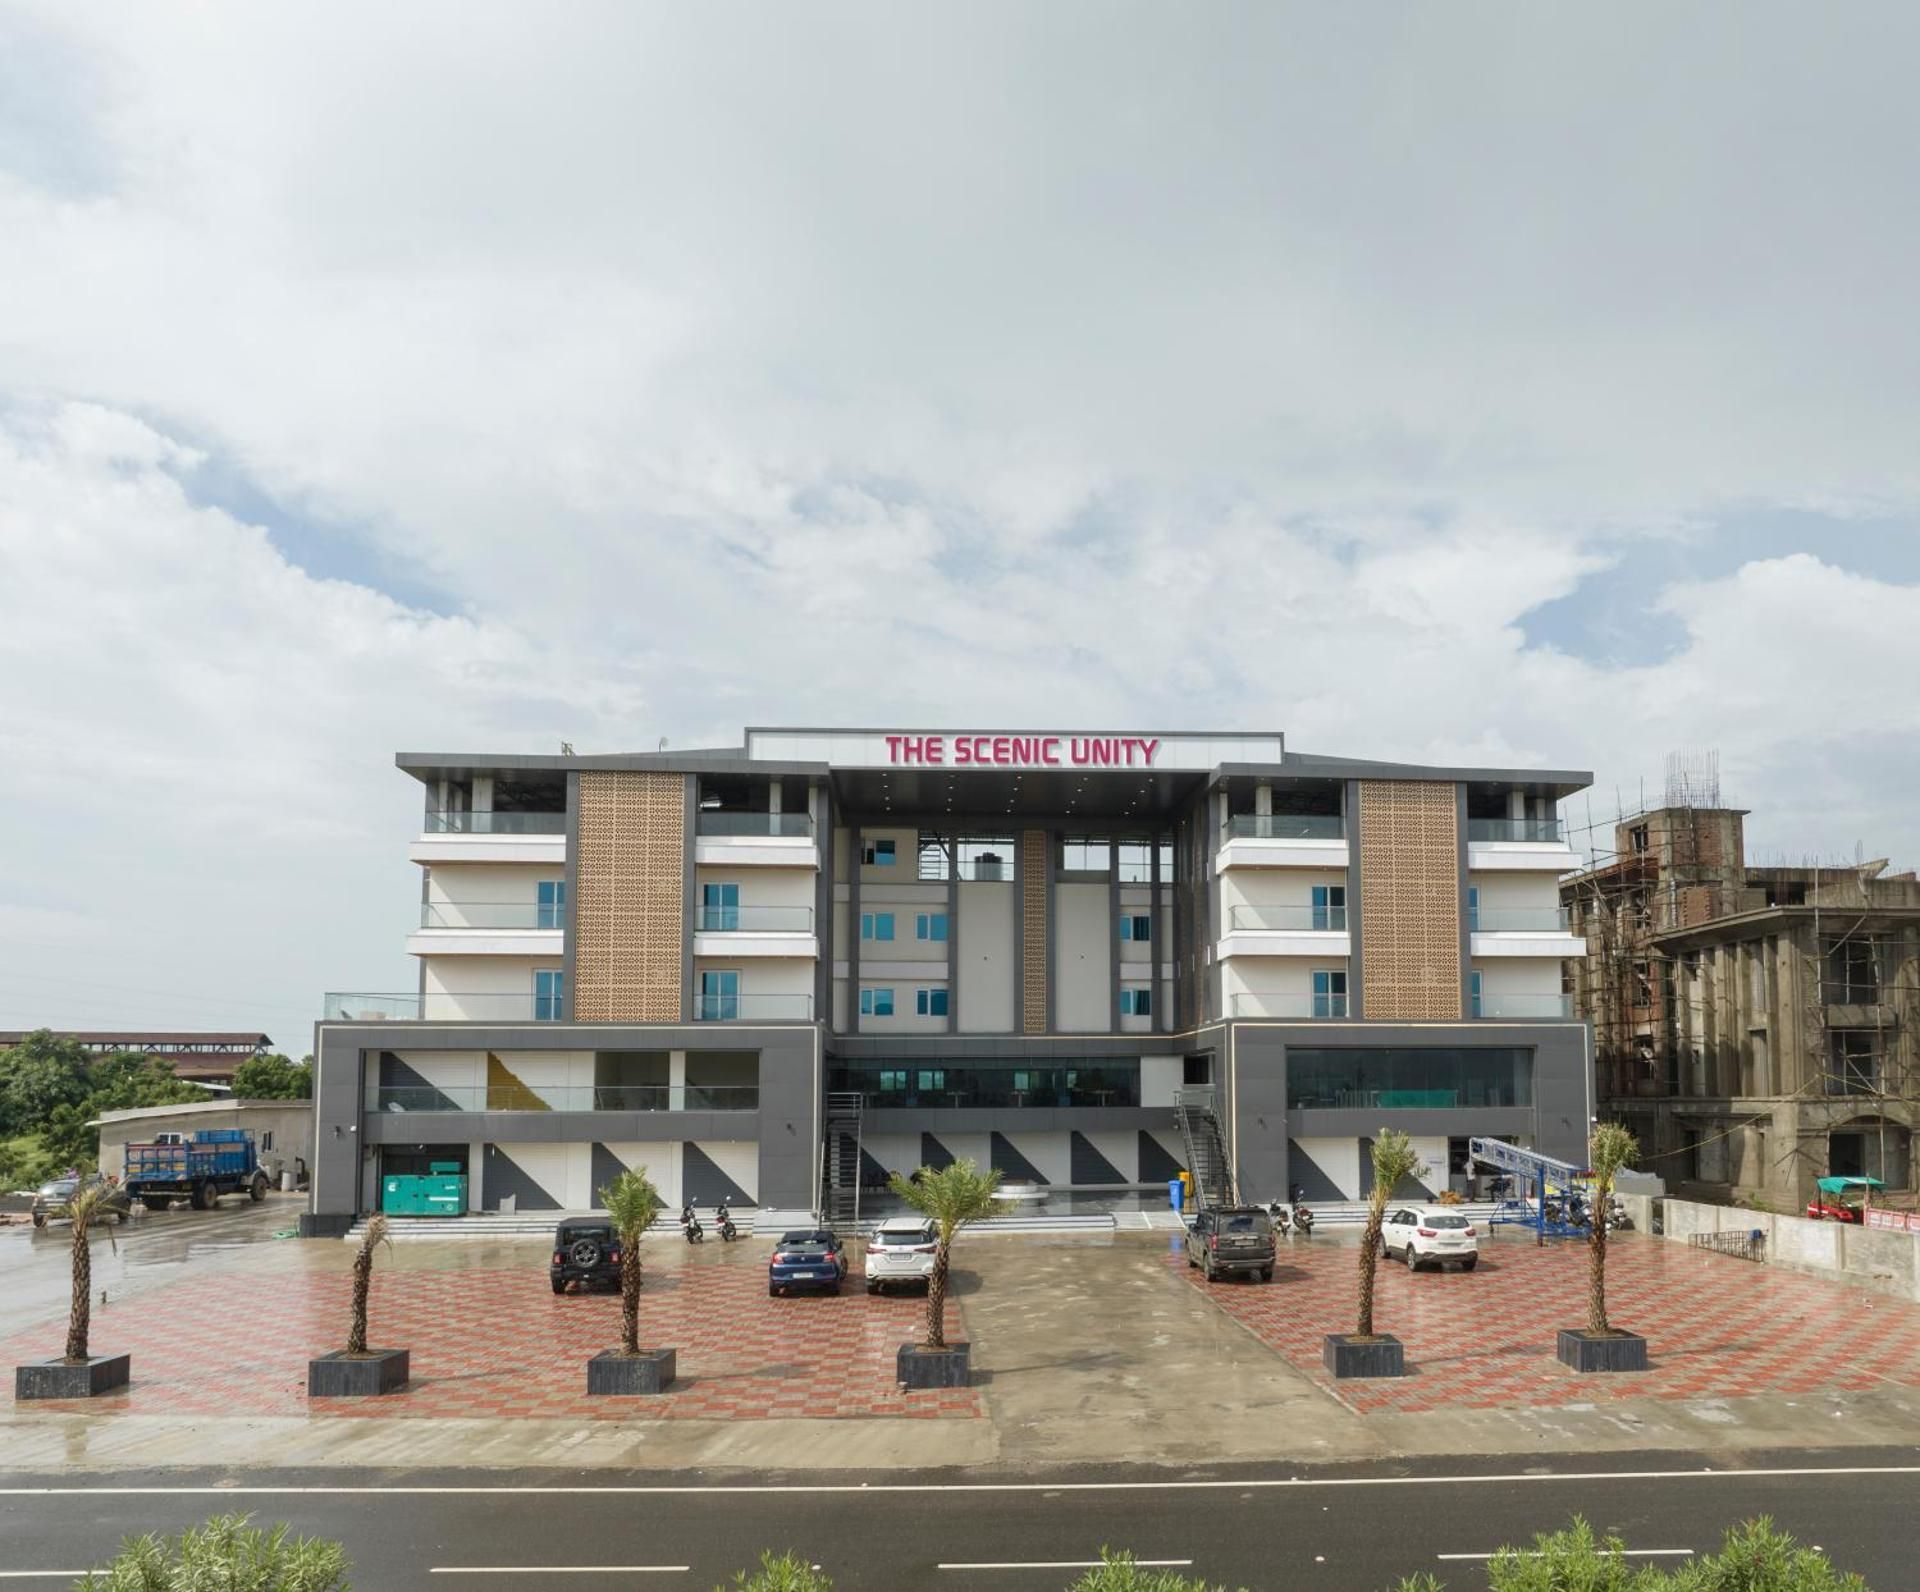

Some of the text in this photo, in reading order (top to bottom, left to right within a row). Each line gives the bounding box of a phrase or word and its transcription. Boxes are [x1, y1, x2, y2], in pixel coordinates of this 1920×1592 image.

[886, 736, 1158, 765] THE SCENIC UNITY
